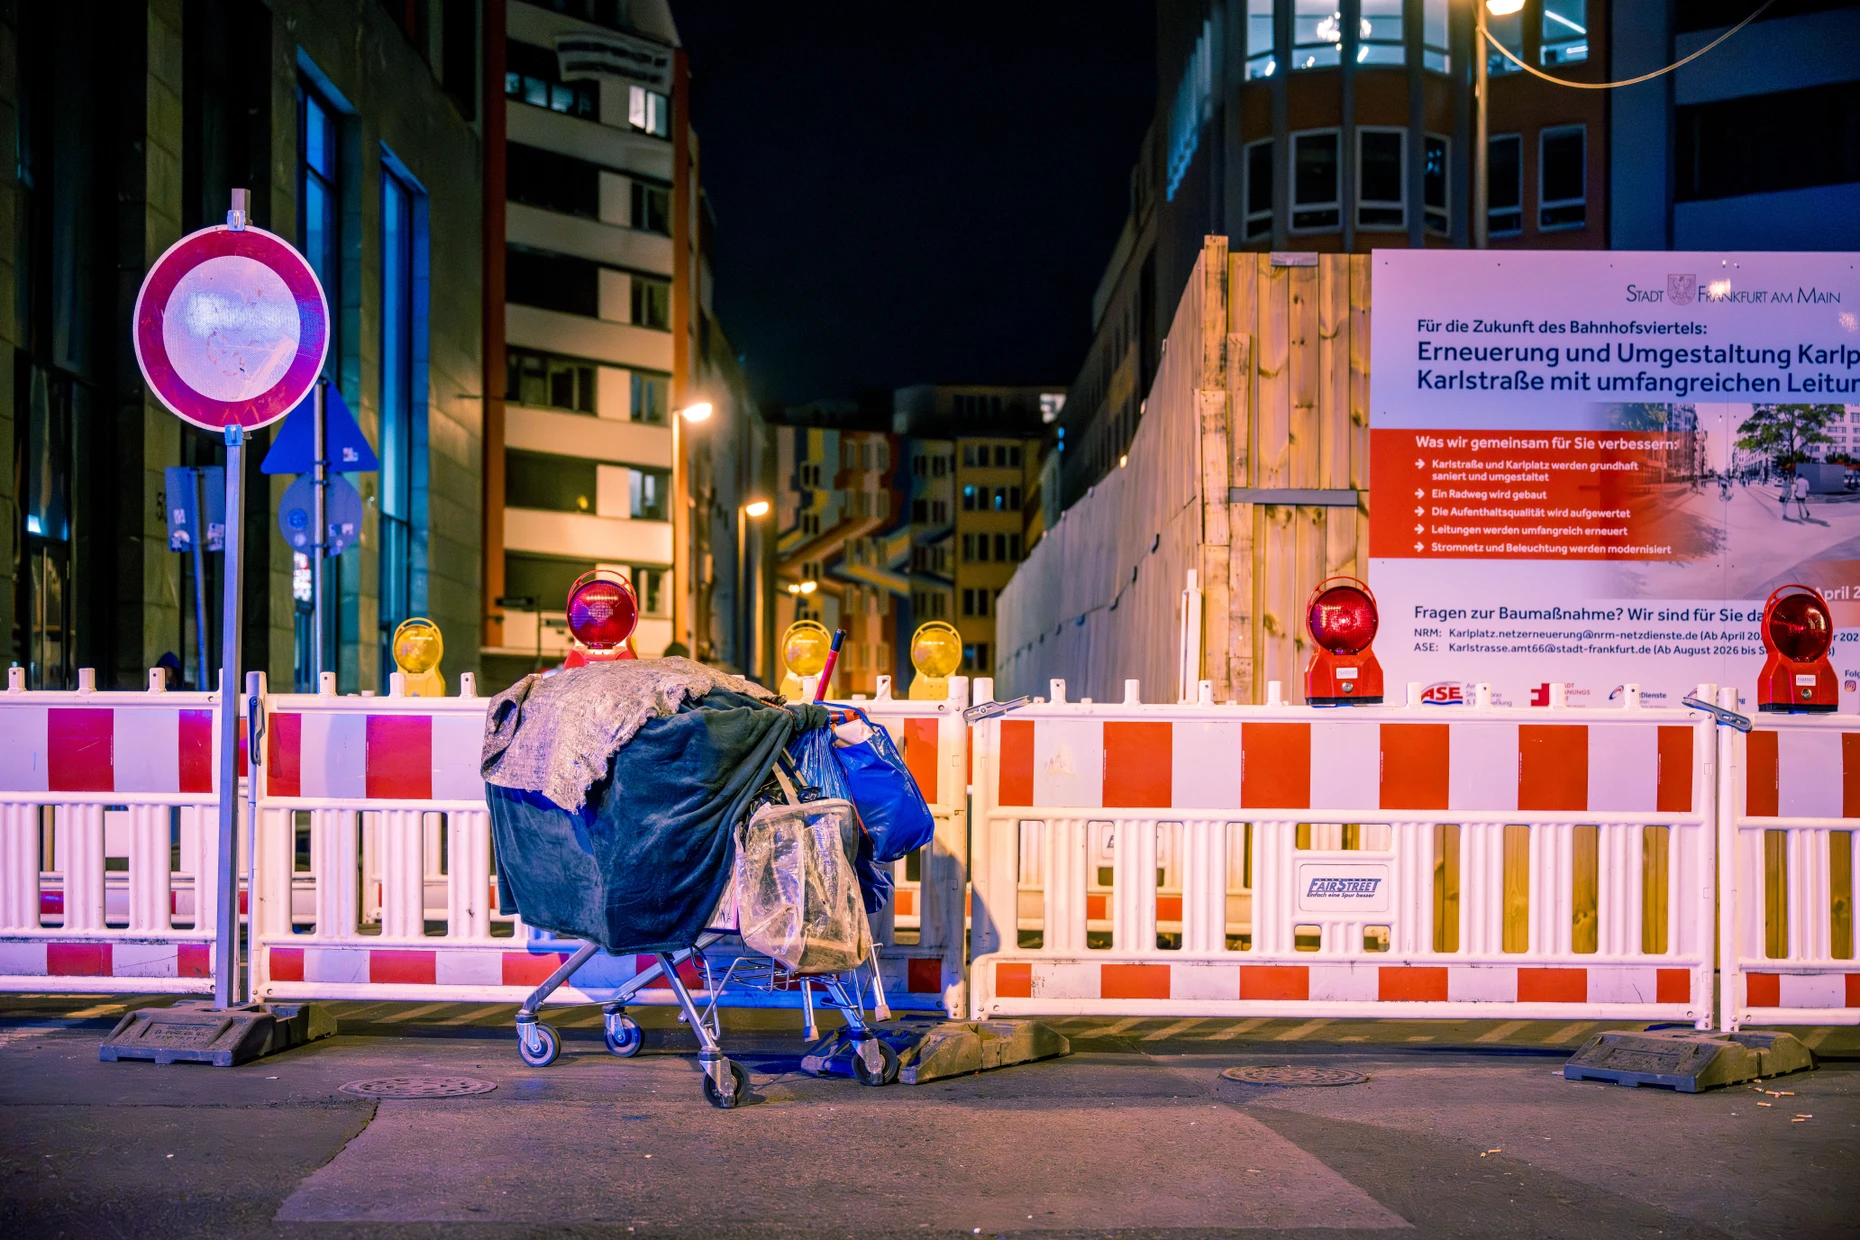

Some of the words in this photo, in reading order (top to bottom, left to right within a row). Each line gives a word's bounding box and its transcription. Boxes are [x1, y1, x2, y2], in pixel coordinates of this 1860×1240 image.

[1626, 284, 1664, 303] STADT
[1797, 286, 1841, 304] MAIN
[1417, 319, 1442, 333] Für
[1445, 320, 1469, 333] die
[1473, 320, 1535, 333] Zukunft
[1538, 320, 1566, 334] des
[1570, 320, 1707, 335] Bahnhofsviertels:
[1418, 341, 1559, 367] Erneuerung
[1566, 342, 1610, 362] und
[1617, 343, 1791, 369] Umgestaltung
[1798, 344, 1860, 370] Karlp
[1417, 369, 1545, 390] Karlstraße
[1550, 371, 1591, 391] mit
[1597, 371, 1781, 397] umfangreichen
[1415, 435, 1444, 448] Was
[1446, 436, 1468, 448] wir
[1470, 436, 1549, 451] gemeinsam
[1551, 437, 1571, 449] für
[1574, 437, 1595, 450] Sie
[1598, 438, 1678, 451] verbessern:
[1432, 459, 1484, 469] Karlstraße
[1485, 460, 1504, 469] und
[1506, 460, 1550, 471] Karlplatz
[1551, 460, 1588, 470] werden
[1589, 461, 1639, 472] grundhaft
[1432, 471, 1466, 481] saniert
[1468, 472, 1487, 481] und
[1488, 472, 1550, 483] umgestaltet
[1431, 489, 1447, 499] Ein
[1449, 489, 1487, 500] Radweg
[1489, 490, 1510, 499] wird
[1512, 490, 1547, 501] gebaut
[1431, 507, 1449, 516] Die
[1450, 507, 1545, 519] Aufenthaltsqualität
[1547, 508, 1568, 517] wird
[1570, 508, 1631, 520] aufgewertet
[1431, 525, 1481, 536] Leitungen
[1483, 525, 1520, 535] werden
[1521, 526, 1583, 537] umfangreich
[1584, 527, 1628, 536] erneuert
[1431, 542, 1484, 552] Stromnetz
[1485, 543, 1504, 552] und
[1506, 543, 1568, 555] Beleuchtung
[1569, 544, 1606, 554] werden
[1607, 544, 1672, 554] modernisiert
[1414, 605, 1467, 622] Fragen
[1470, 609, 1495, 619] zur
[1499, 606, 1624, 620] Baumaßnahme?
[1627, 608, 1654, 621] Wir
[1658, 608, 1689, 621] sind
[1693, 608, 1715, 622] für
[1719, 608, 1743, 622] Sie
[1414, 628, 1442, 638] NRM:
[1449, 628, 1698, 641] Karlplatz.netzerneuerung@nrm-netzdienste.de
[1700, 631, 1718, 641] (Ab
[1720, 631, 1745, 642] April
[1747, 631, 1763, 641] 20
[1414, 643, 1439, 652] ASE:
[1449, 643, 1651, 655] Karlstrasse.amt66@stadt-frankfurt.de
[1653, 645, 1671, 655] (Ab
[1673, 645, 1710, 657] August
[1713, 646, 1739, 655] 2026
[1741, 646, 1756, 655] bis
[1421, 686, 1463, 700] ASE
